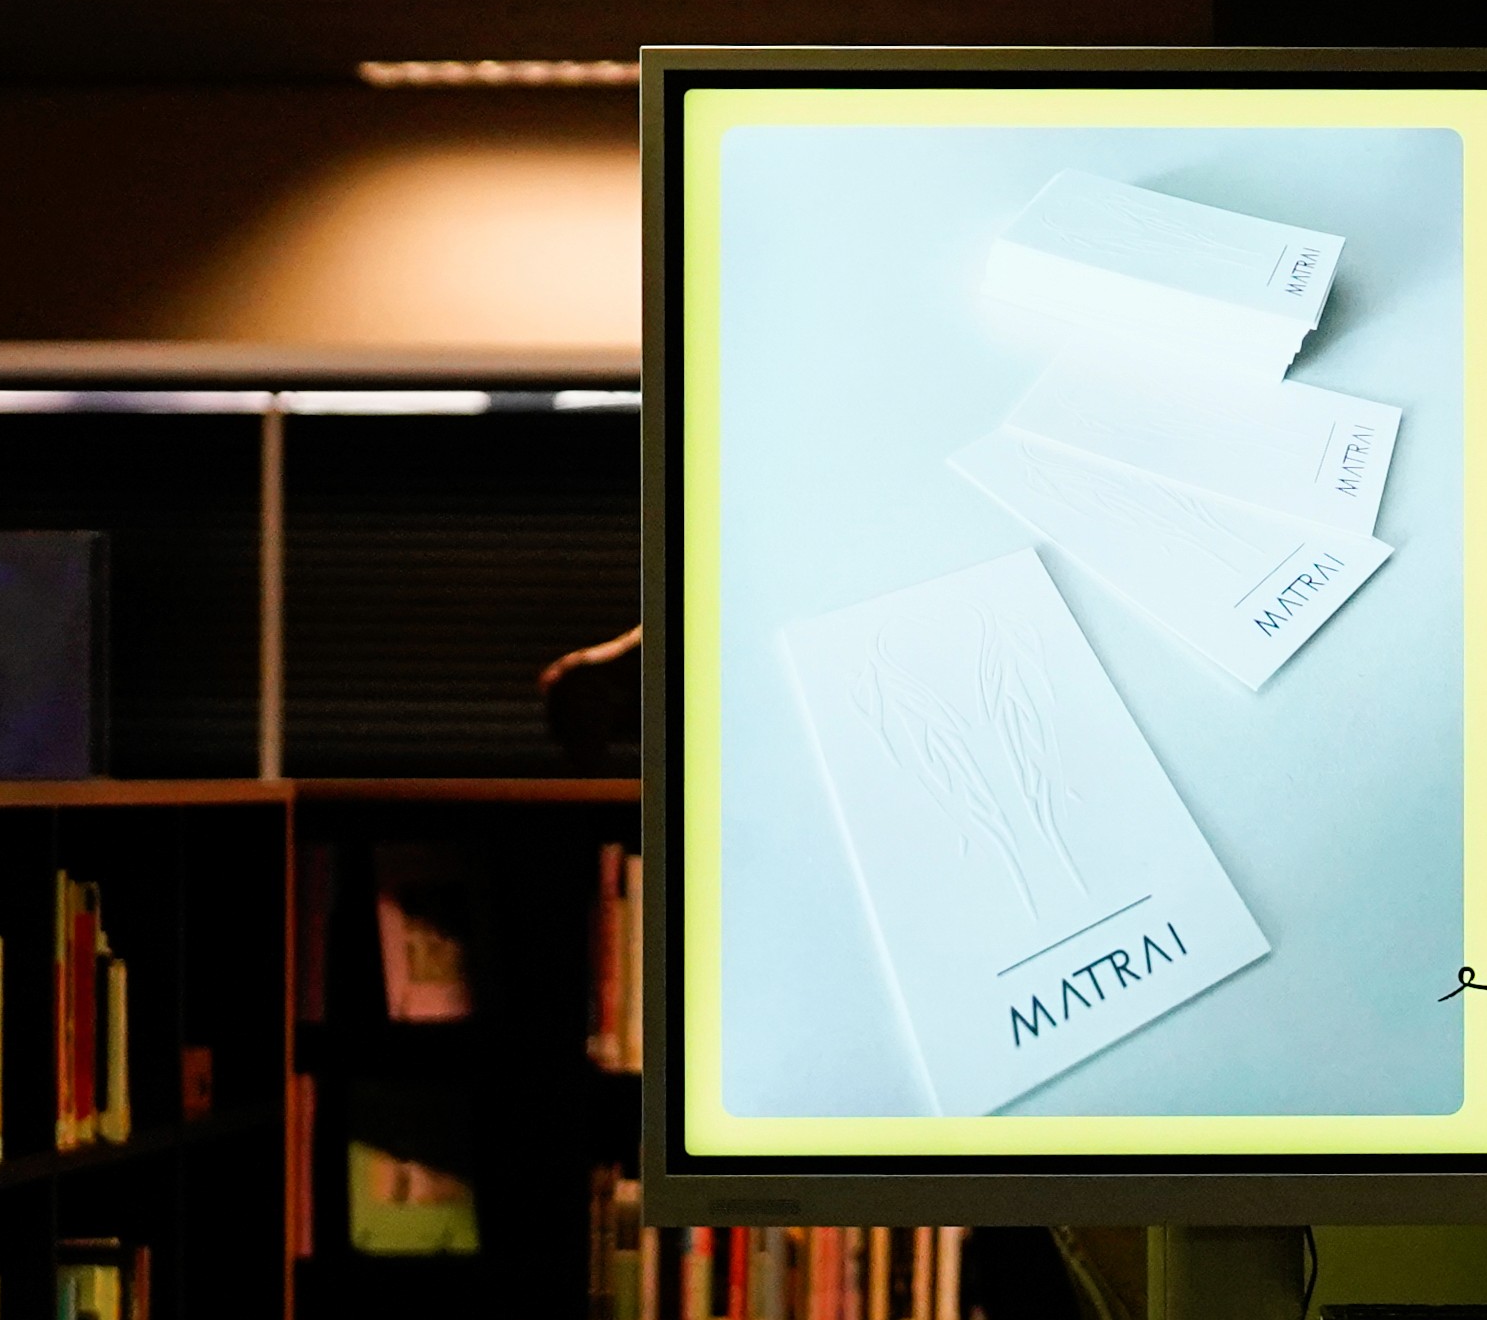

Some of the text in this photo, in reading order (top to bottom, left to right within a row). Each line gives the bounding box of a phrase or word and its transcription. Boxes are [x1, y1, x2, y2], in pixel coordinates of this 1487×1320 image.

[1285, 246, 1321, 297] MATRAI
[1334, 423, 1376, 498] MATRAI
[1253, 552, 1345, 638] MATRAI
[1010, 921, 1188, 1048] MATRAI
